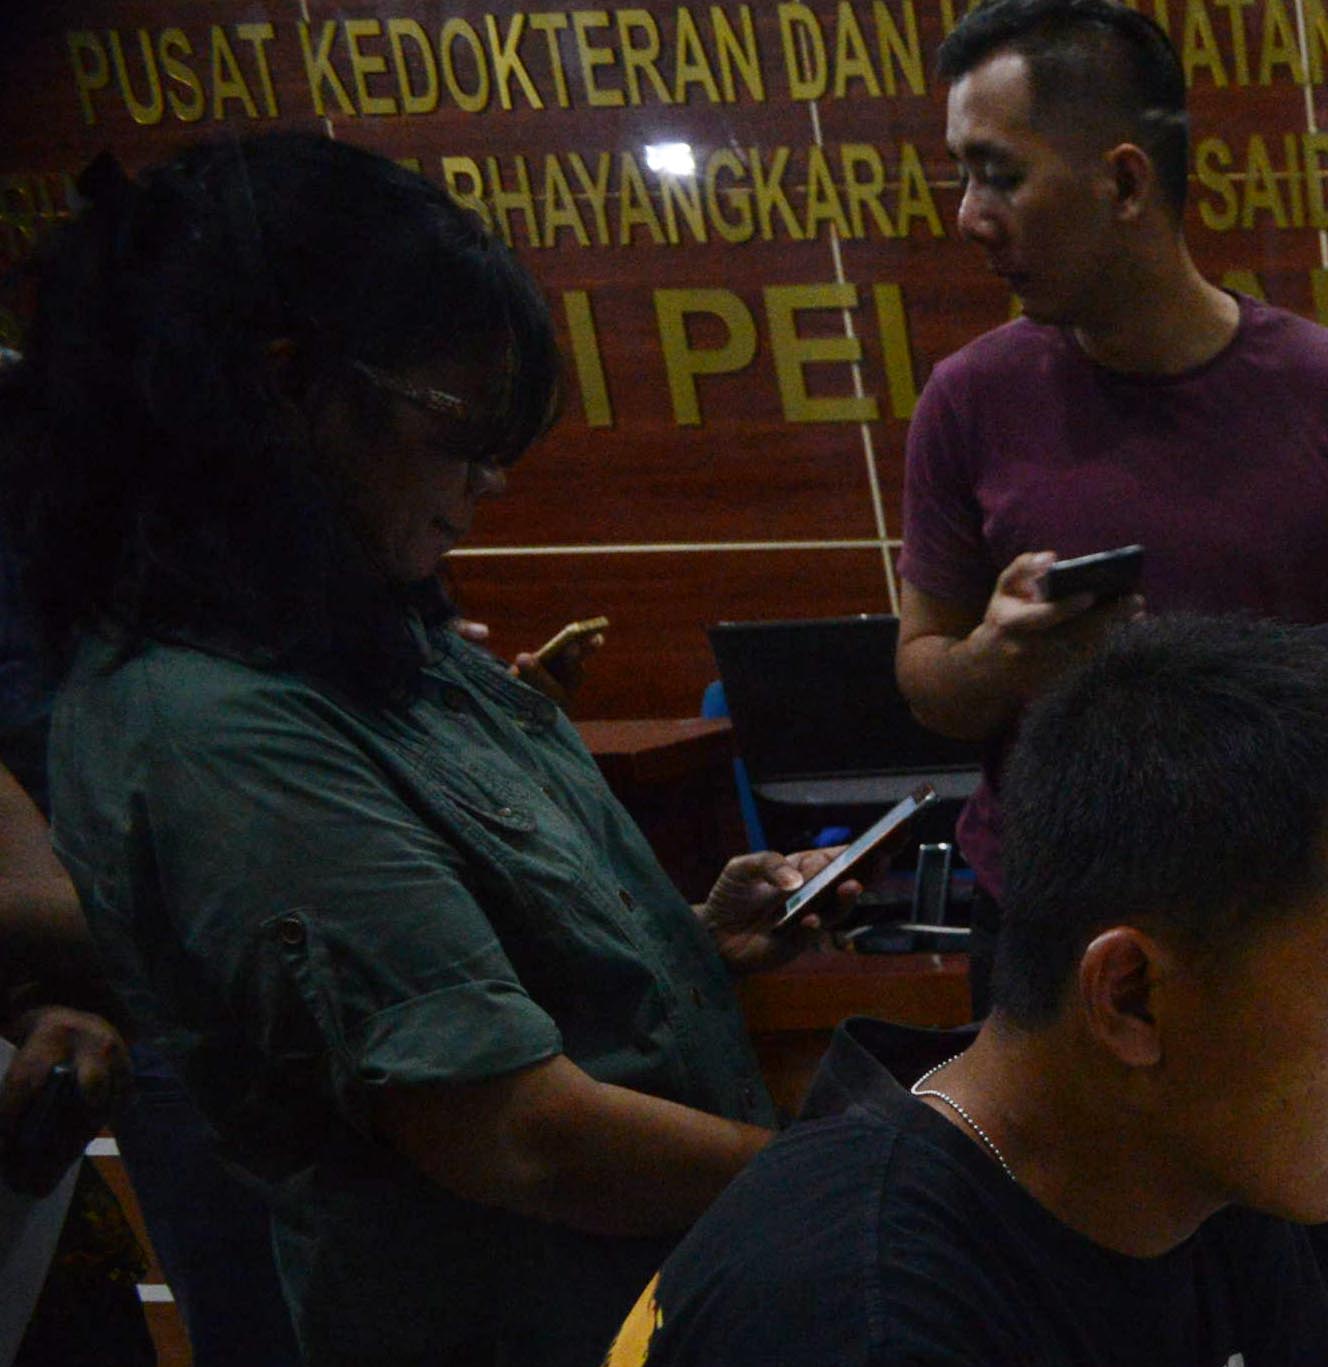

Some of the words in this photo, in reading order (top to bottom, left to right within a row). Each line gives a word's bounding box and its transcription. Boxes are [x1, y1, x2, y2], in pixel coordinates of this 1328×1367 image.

[67, 21, 281, 126] PUSAT
[298, 3, 766, 118] KEDOKTERAN
[777, 0, 928, 102] DAN
[442, 143, 947, 249] BHAYANGKARA
